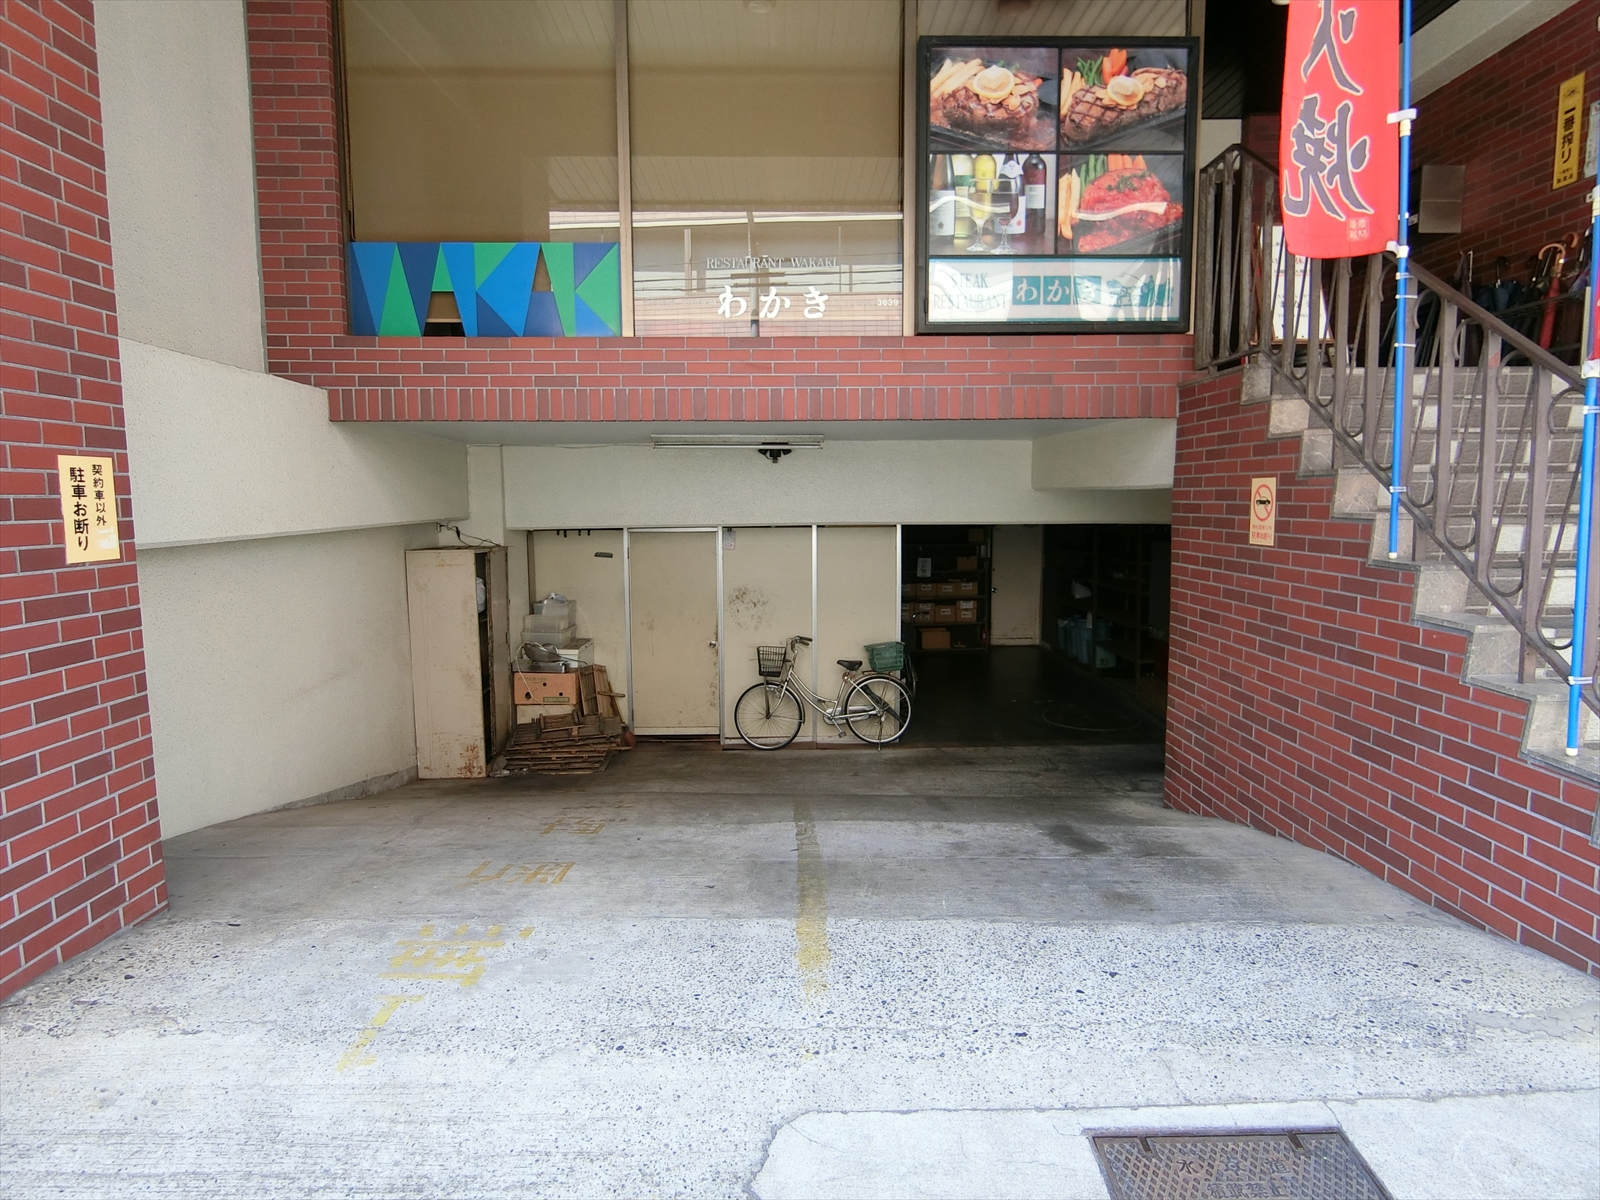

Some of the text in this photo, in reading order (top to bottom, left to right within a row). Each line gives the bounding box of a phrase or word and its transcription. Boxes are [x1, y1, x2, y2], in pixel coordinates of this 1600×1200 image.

[1561, 107, 1576, 164] 一番搾り
[706, 256, 838, 269] RESTAURANT WAKAKI
[951, 272, 989, 288] STEAK
[1014, 277, 1098, 304] わかき
[717, 284, 829, 319] わかき
[876, 298, 899, 307] 3639
[932, 294, 1008, 310] RESTAURANT
[91, 464, 107, 527] 契約車以外
[69, 466, 89, 551] 駐車お断り
[1174, 1159, 1199, 1175] 水
